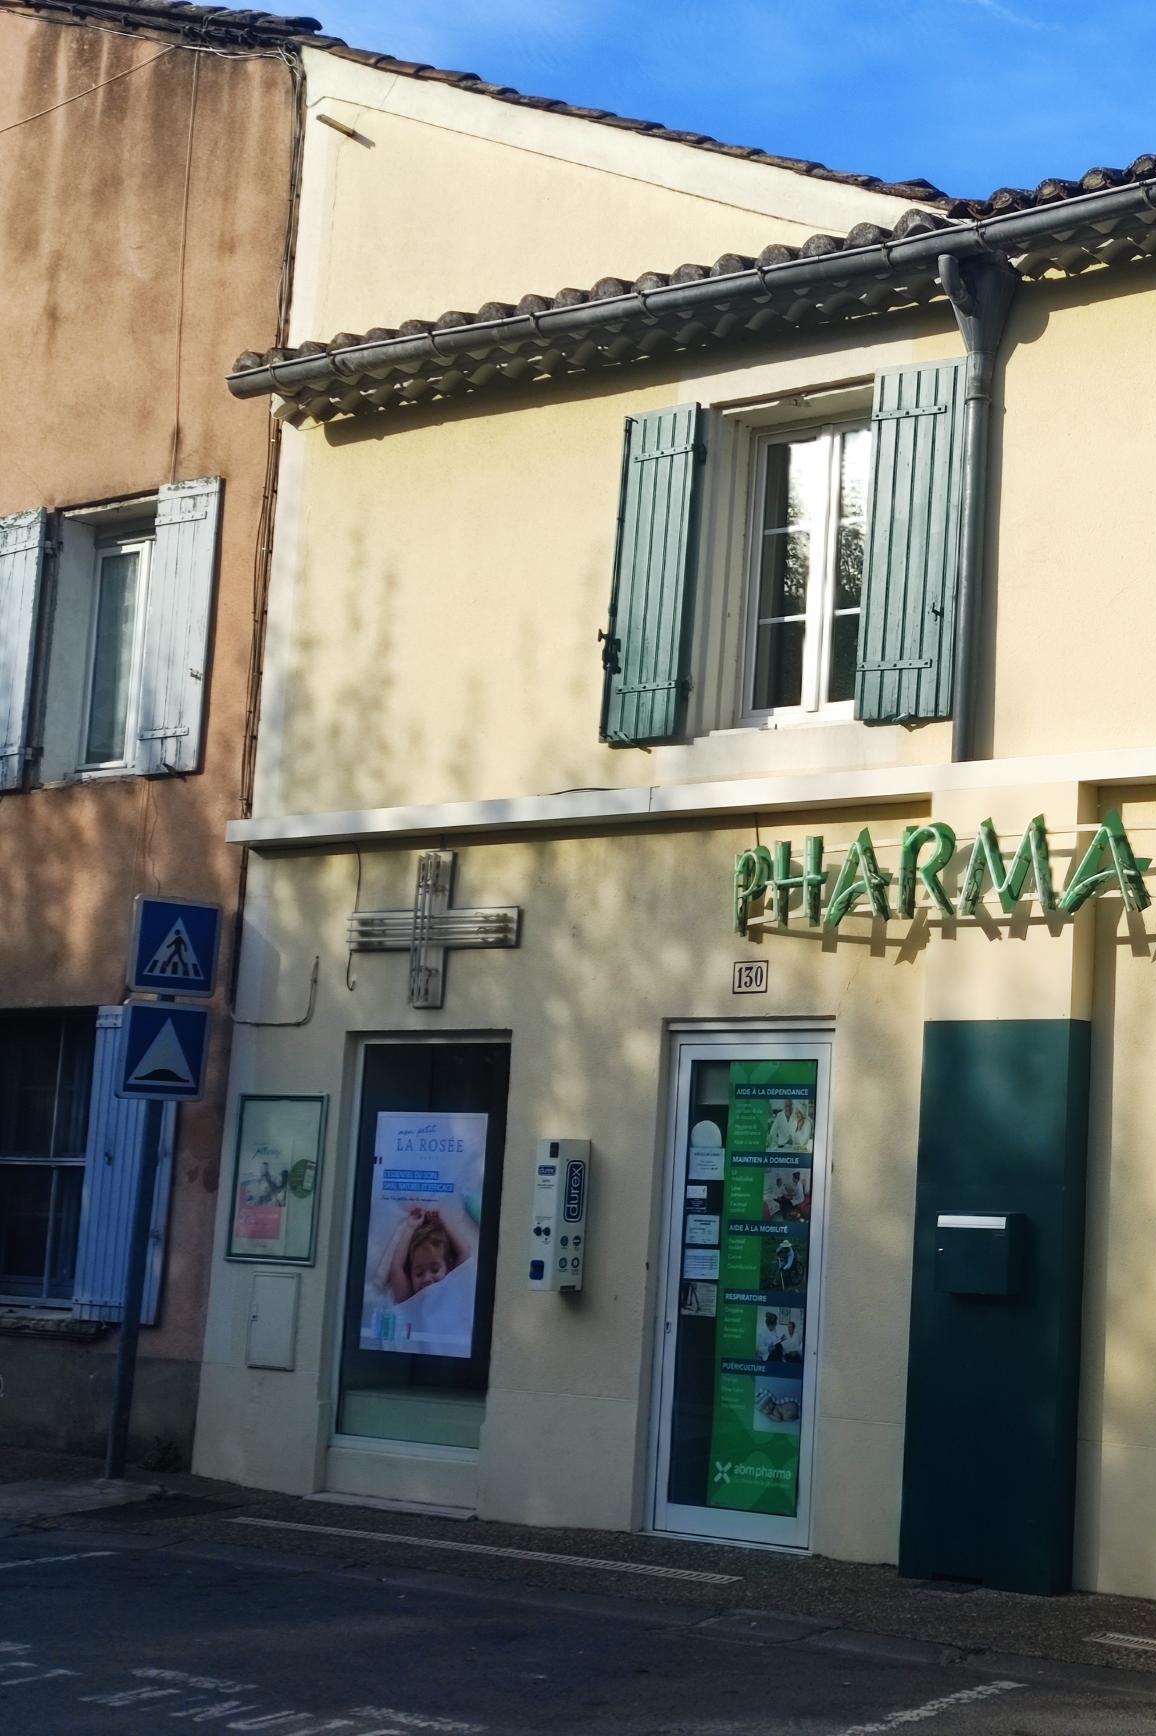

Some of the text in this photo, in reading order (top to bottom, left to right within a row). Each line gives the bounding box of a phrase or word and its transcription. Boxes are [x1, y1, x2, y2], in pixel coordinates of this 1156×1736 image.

[737, 965, 764, 989] 130
[736, 1088, 751, 1096] AIDE
[758, 1088, 766, 1096] LA
[397, 1136, 464, 1153] LA ROSÉE
[732, 1155, 762, 1164] MAINTIEN
[769, 1156, 800, 1165] DOMICILE
[565, 1166, 581, 1217] durex
[725, 1293, 767, 1302] RESPIRATOIRE
[721, 1361, 767, 1372] PUÉRICULTURE
